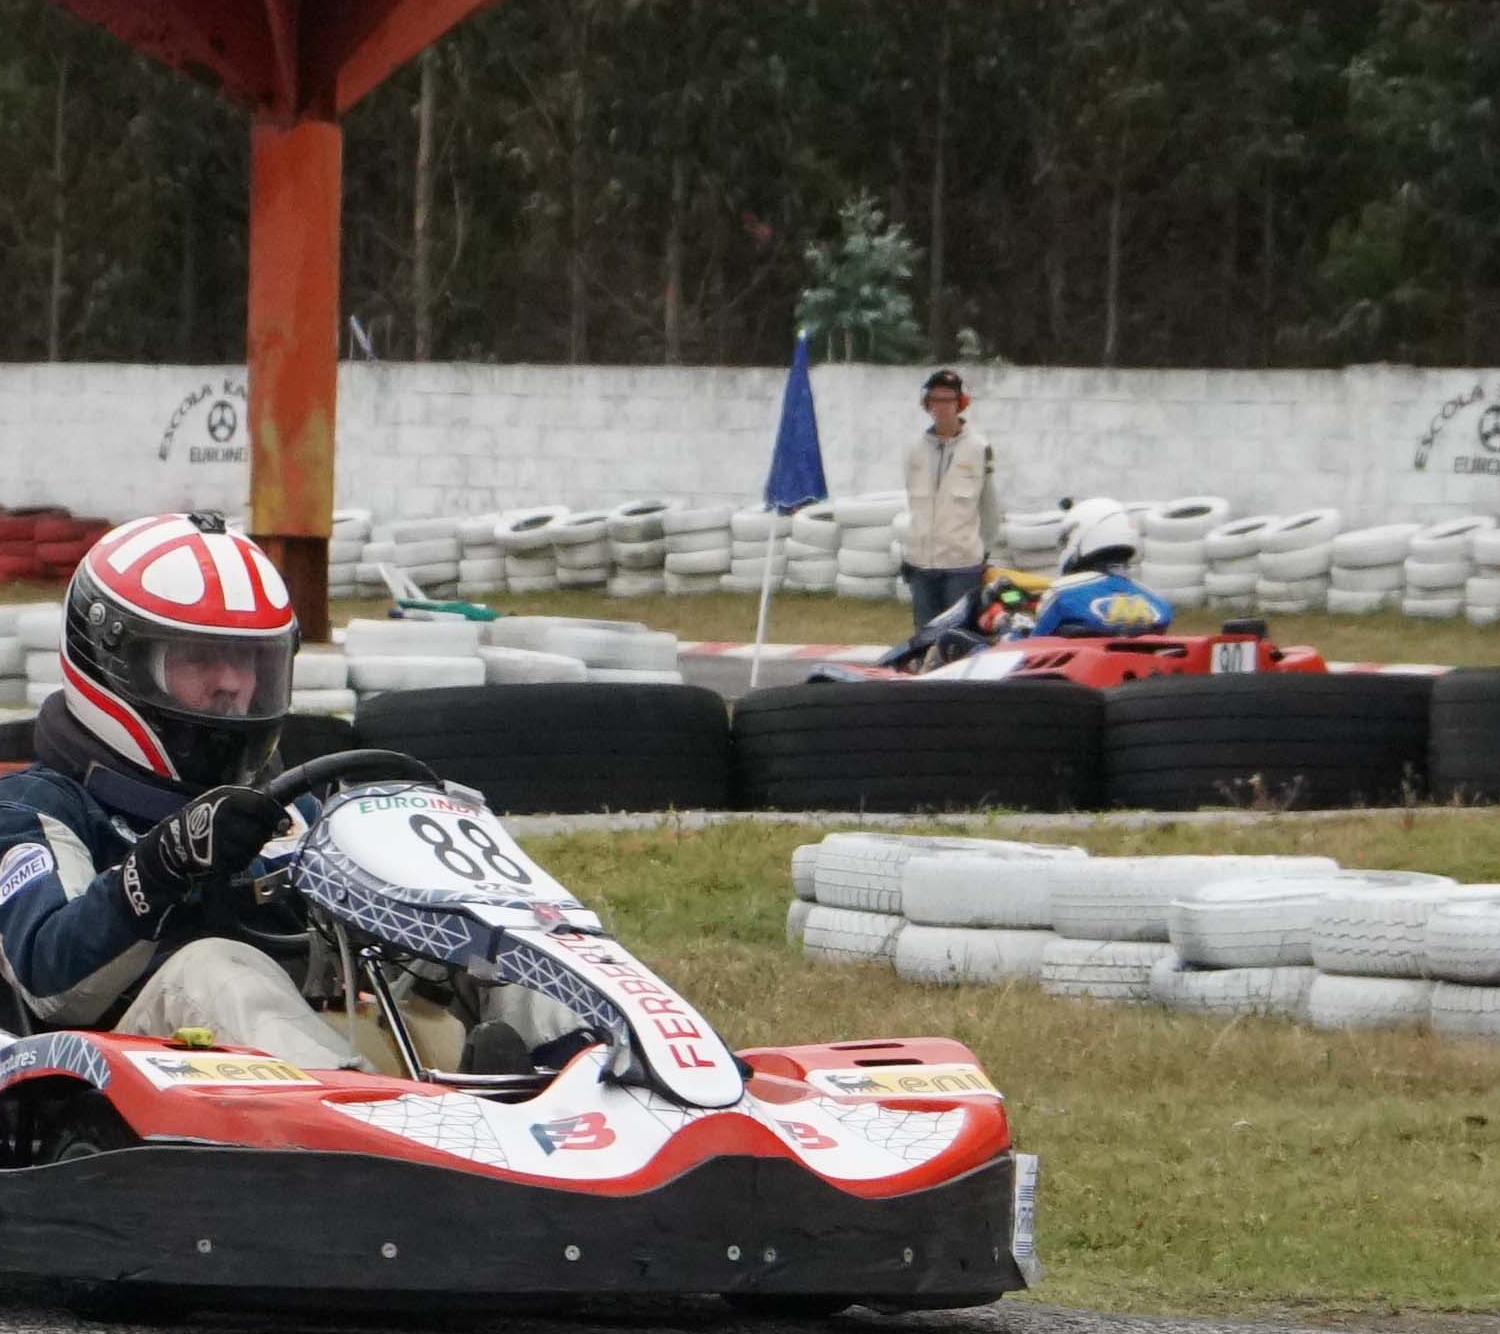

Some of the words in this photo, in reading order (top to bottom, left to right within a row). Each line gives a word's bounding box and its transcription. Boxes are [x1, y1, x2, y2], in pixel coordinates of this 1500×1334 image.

[408, 813, 533, 885] 88
[1, 857, 47, 899] ORMEI
[124, 851, 150, 916] parco
[899, 1068, 986, 1092] eni
